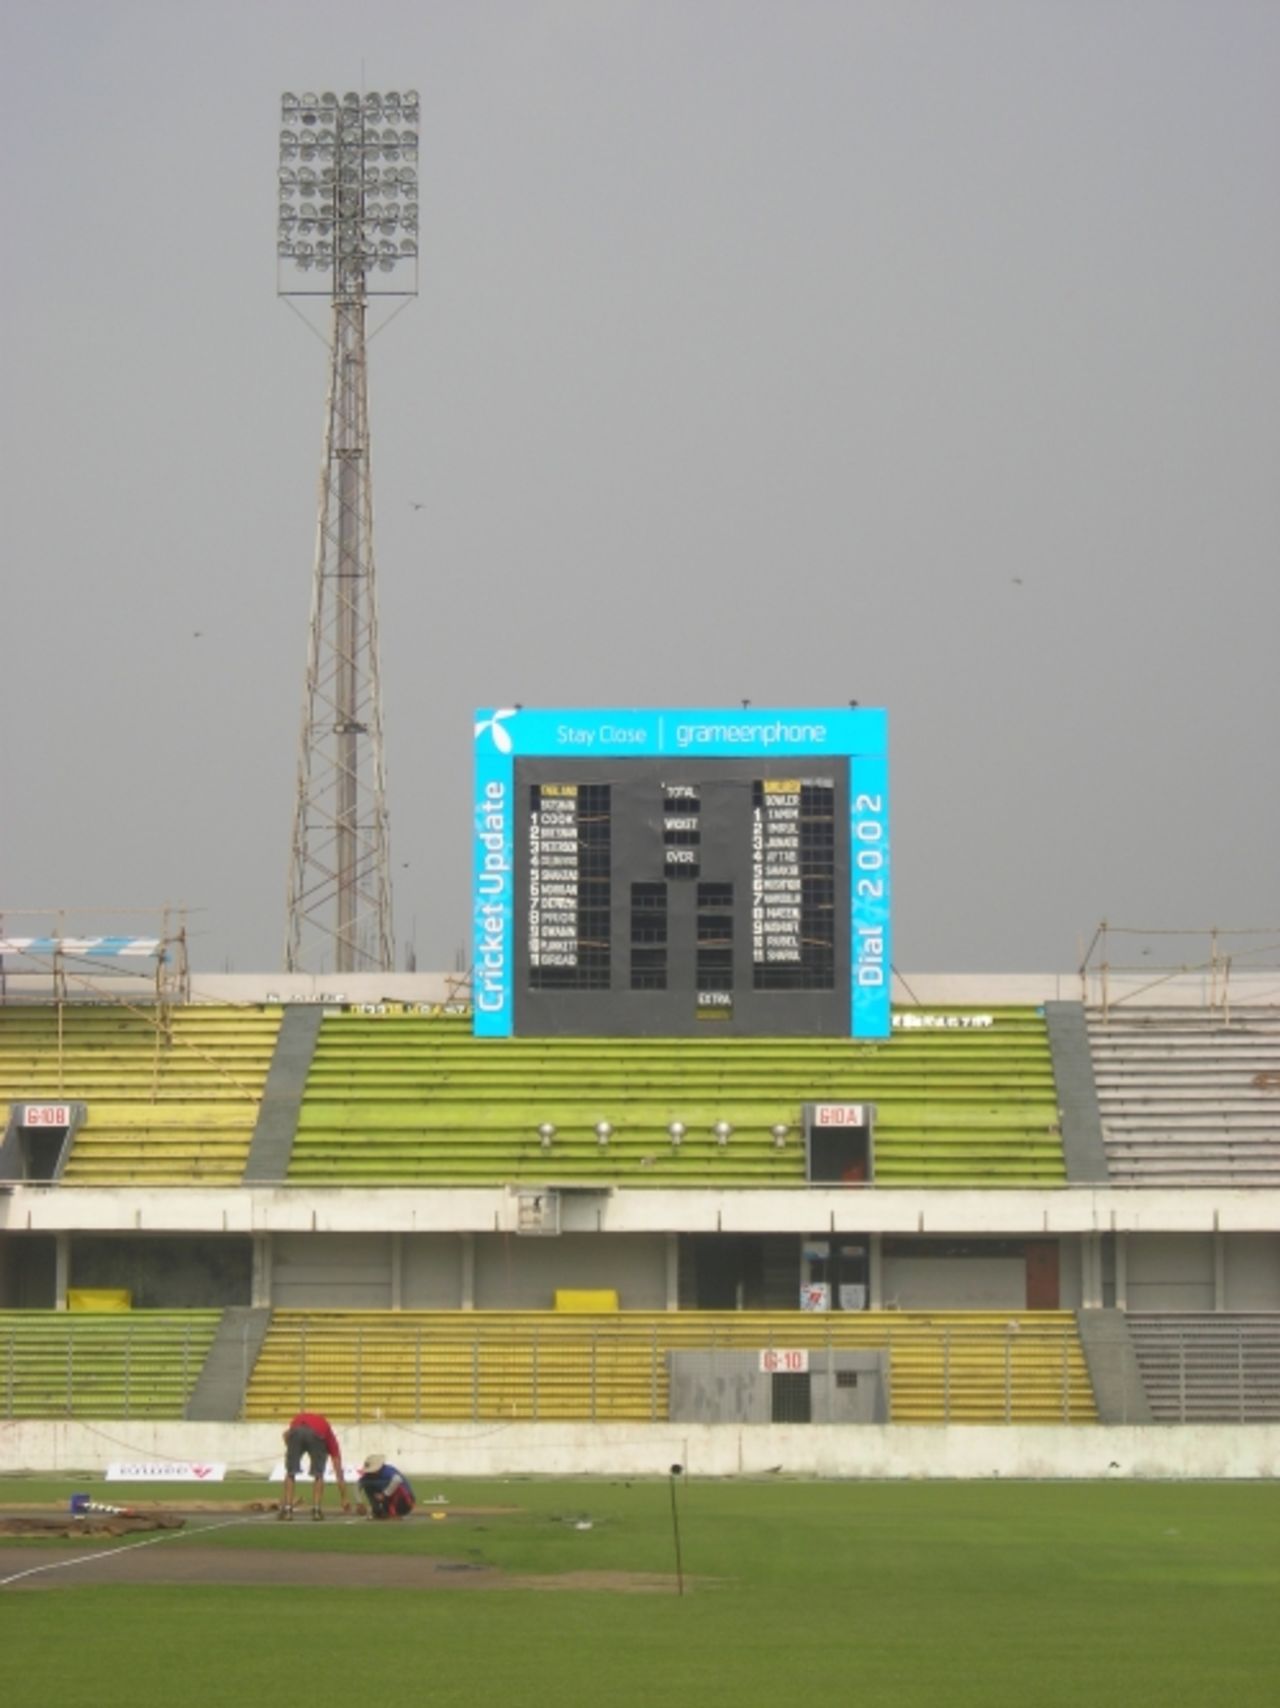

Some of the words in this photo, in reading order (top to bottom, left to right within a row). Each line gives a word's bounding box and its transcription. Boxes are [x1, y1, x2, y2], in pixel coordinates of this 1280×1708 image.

[557, 725, 596, 747] Stay
[598, 725, 647, 744] Close
[676, 721, 826, 748] grameenphone
[479, 782, 511, 896] Update
[541, 813, 574, 825] COOK
[479, 904, 505, 1012] Cricket
[857, 926, 884, 987] Dial
